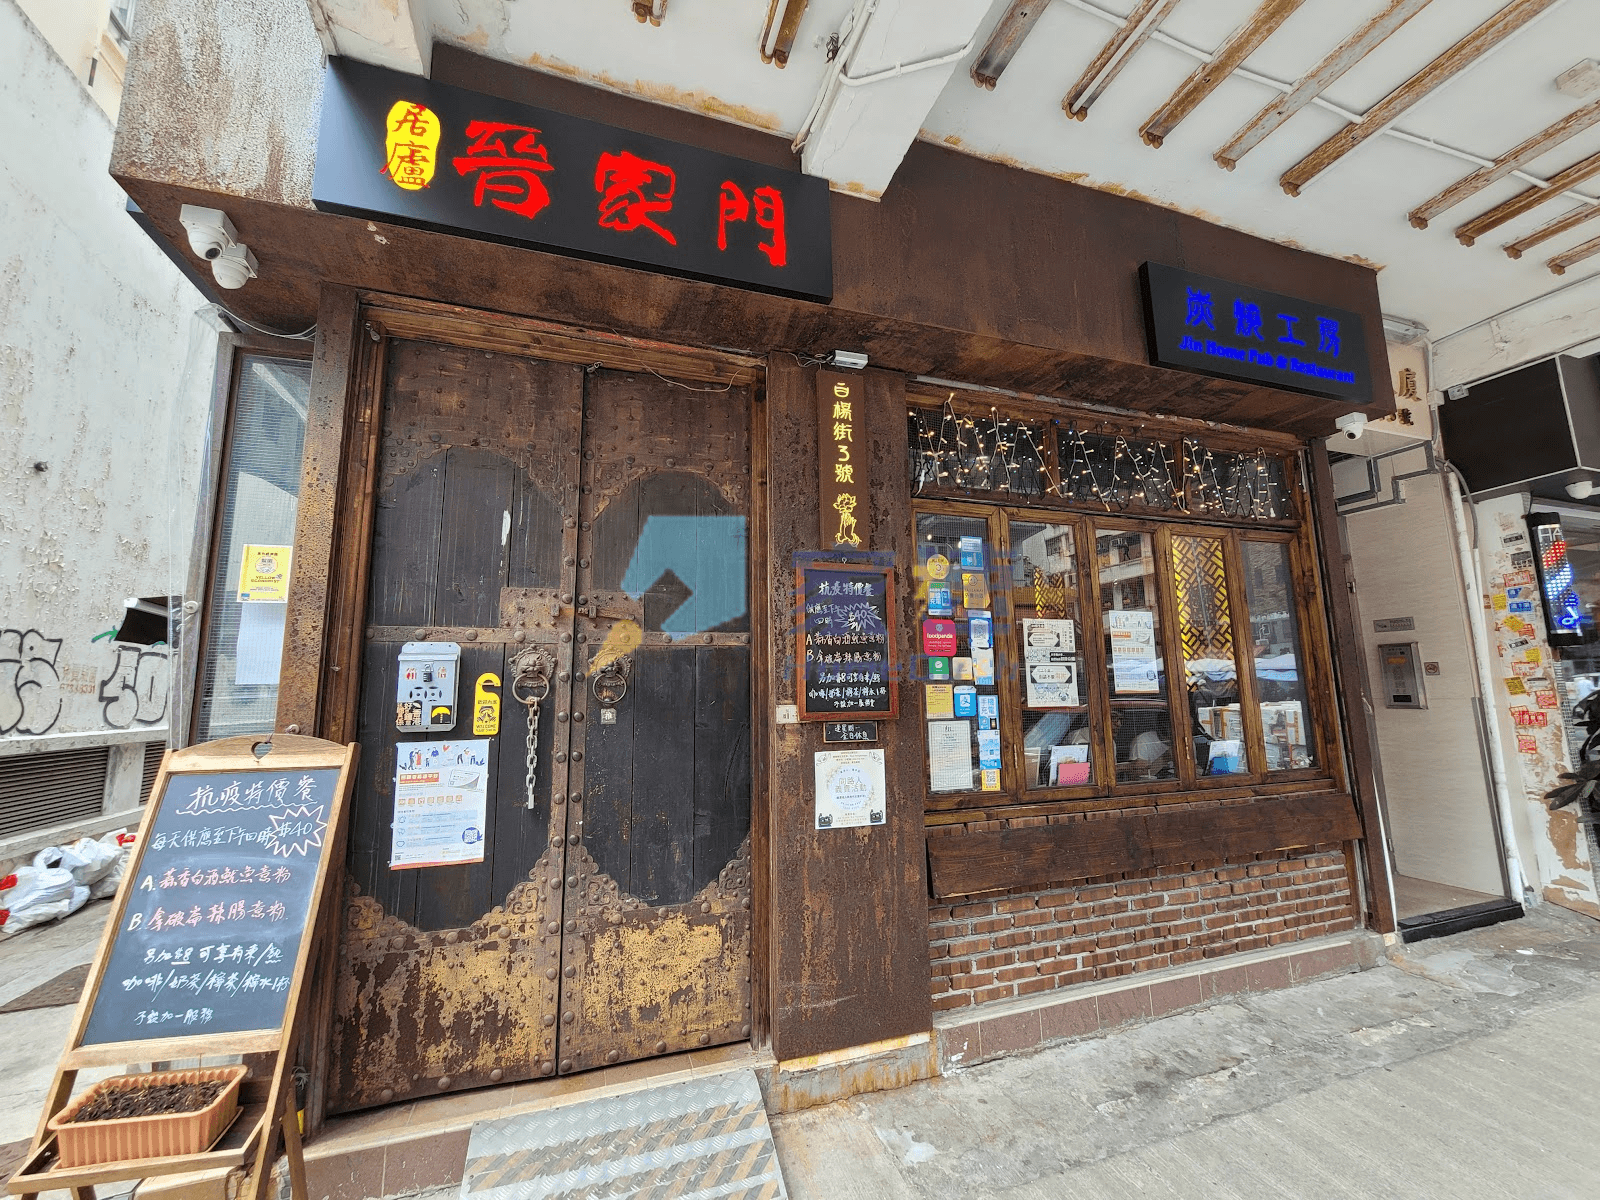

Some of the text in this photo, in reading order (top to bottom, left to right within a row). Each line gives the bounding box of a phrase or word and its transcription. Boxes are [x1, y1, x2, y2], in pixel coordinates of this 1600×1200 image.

[926, 632, 954, 640] foodpanda
[186, 774, 318, 810] 抗疫特價餐
[151, 826, 271, 851] 每天供應至下午四時
[279, 821, 314, 839] $40
